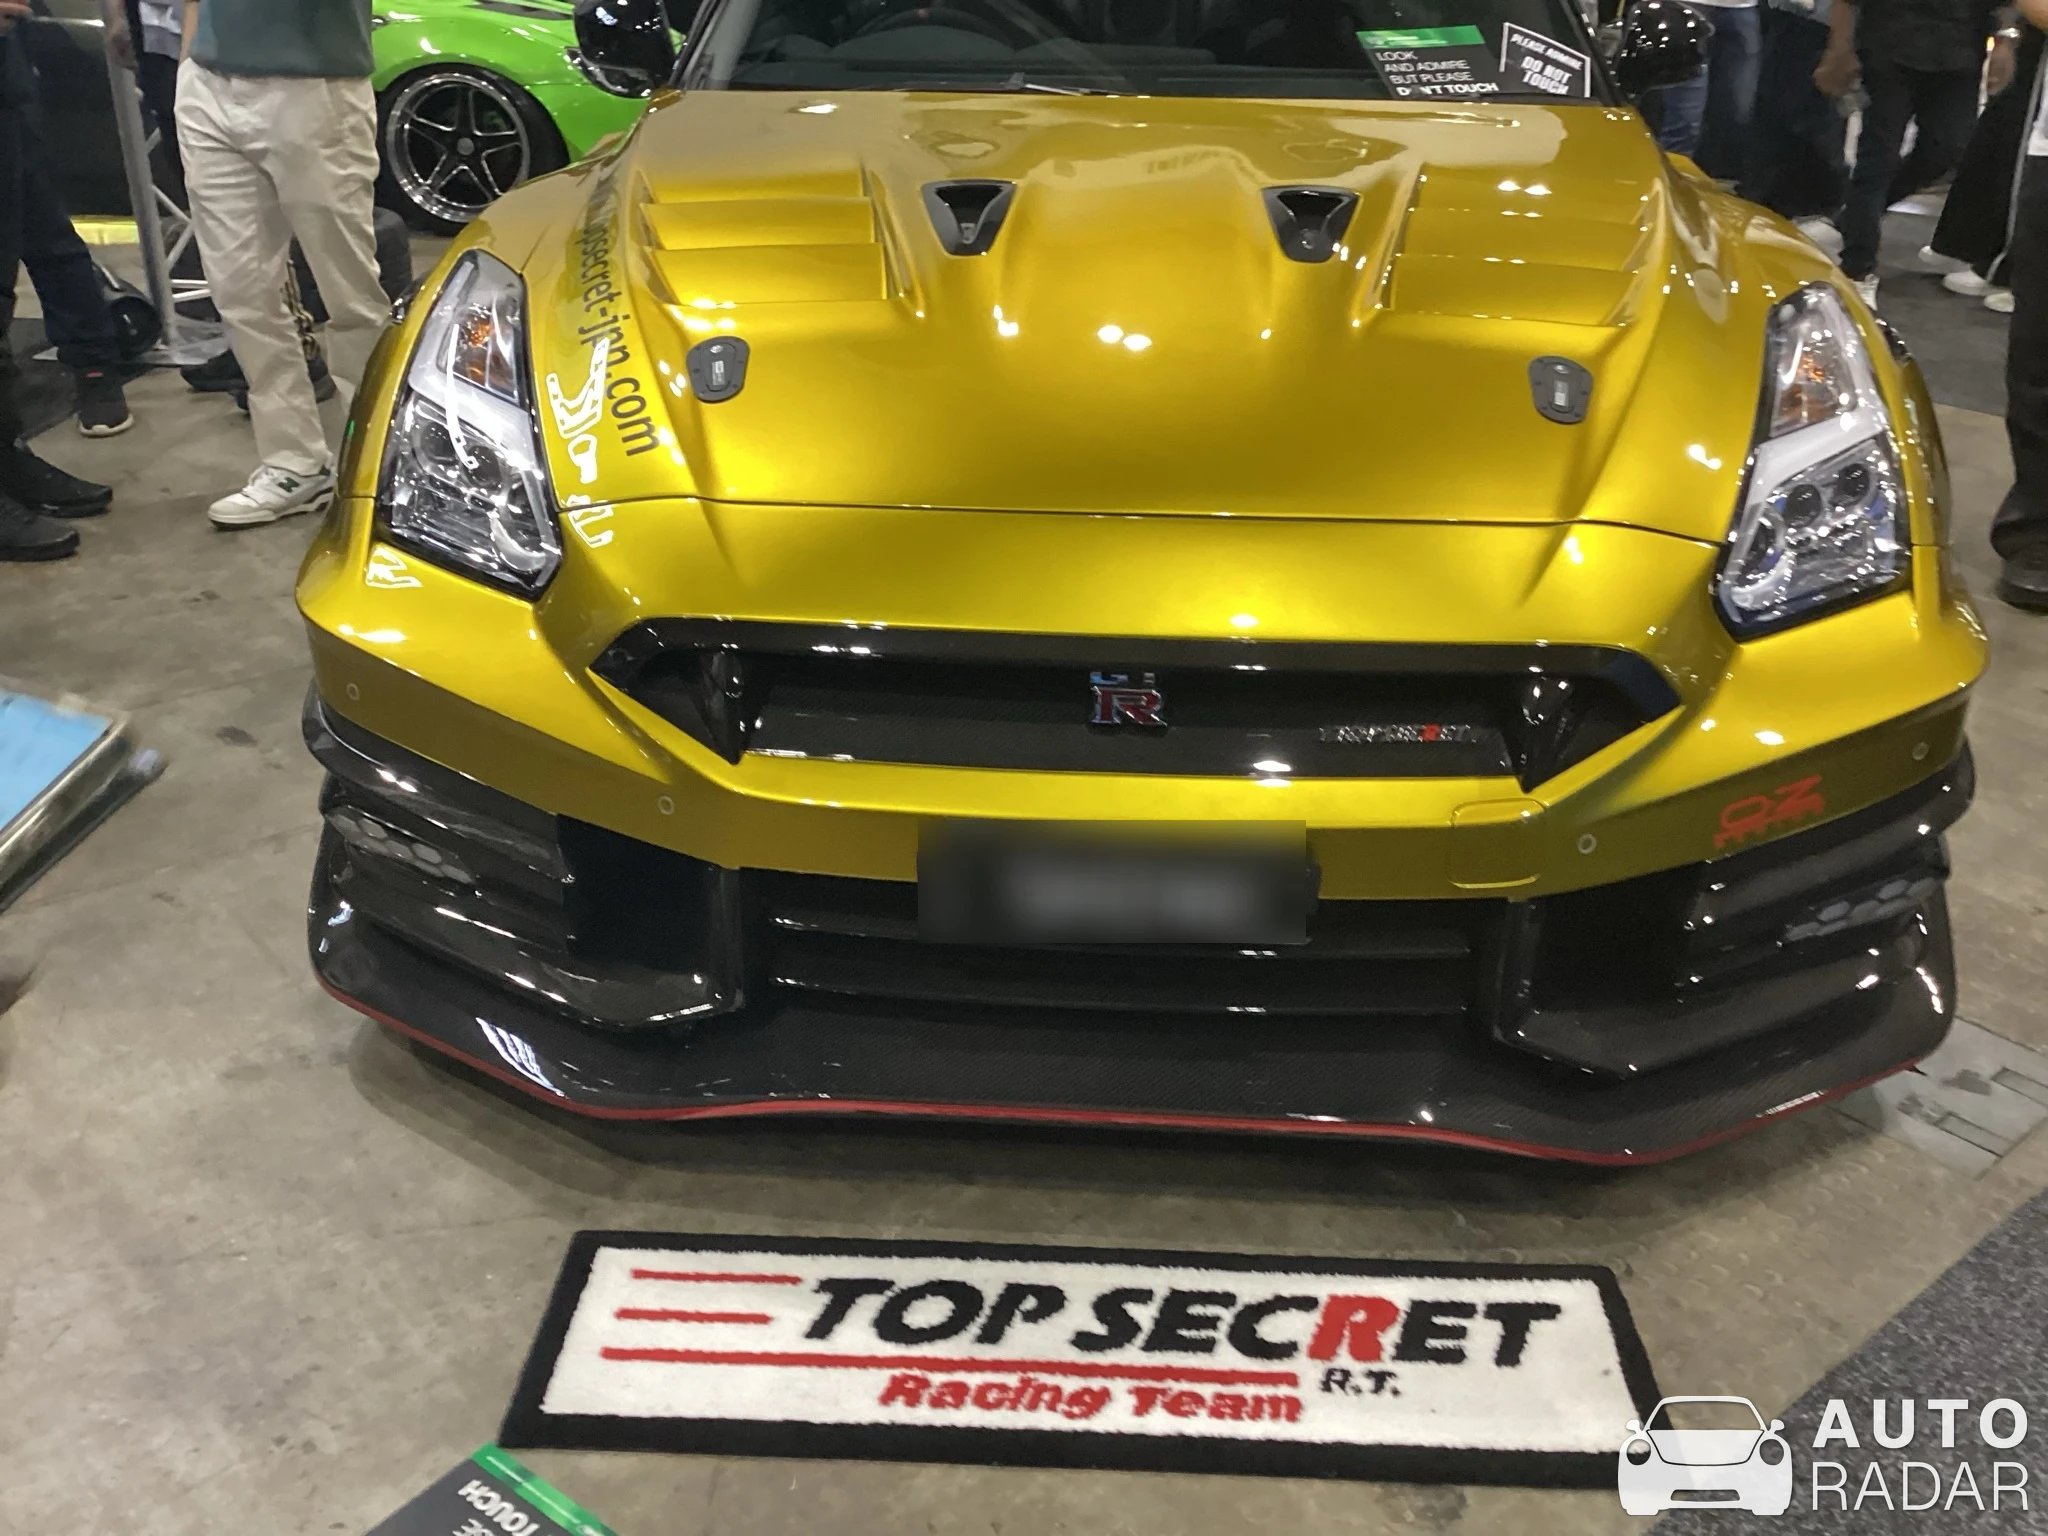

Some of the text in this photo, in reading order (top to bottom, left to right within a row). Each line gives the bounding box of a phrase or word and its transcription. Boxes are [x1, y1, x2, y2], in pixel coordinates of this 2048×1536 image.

[1375, 51, 1418, 61] LOOK
[1384, 60, 1470, 72] AND ADMIRE
[1389, 71, 1474, 84] BUT PLEASE
[1521, 56, 1572, 84] DO NOT
[1522, 69, 1569, 95] TOUCH
[1396, 82, 1499, 96] DN'T TOUCH
[805, 1278, 1562, 1368] TOP SECRET
[1321, 1368, 1401, 1396] R.T.
[879, 1373, 1302, 1422] Racing Team
